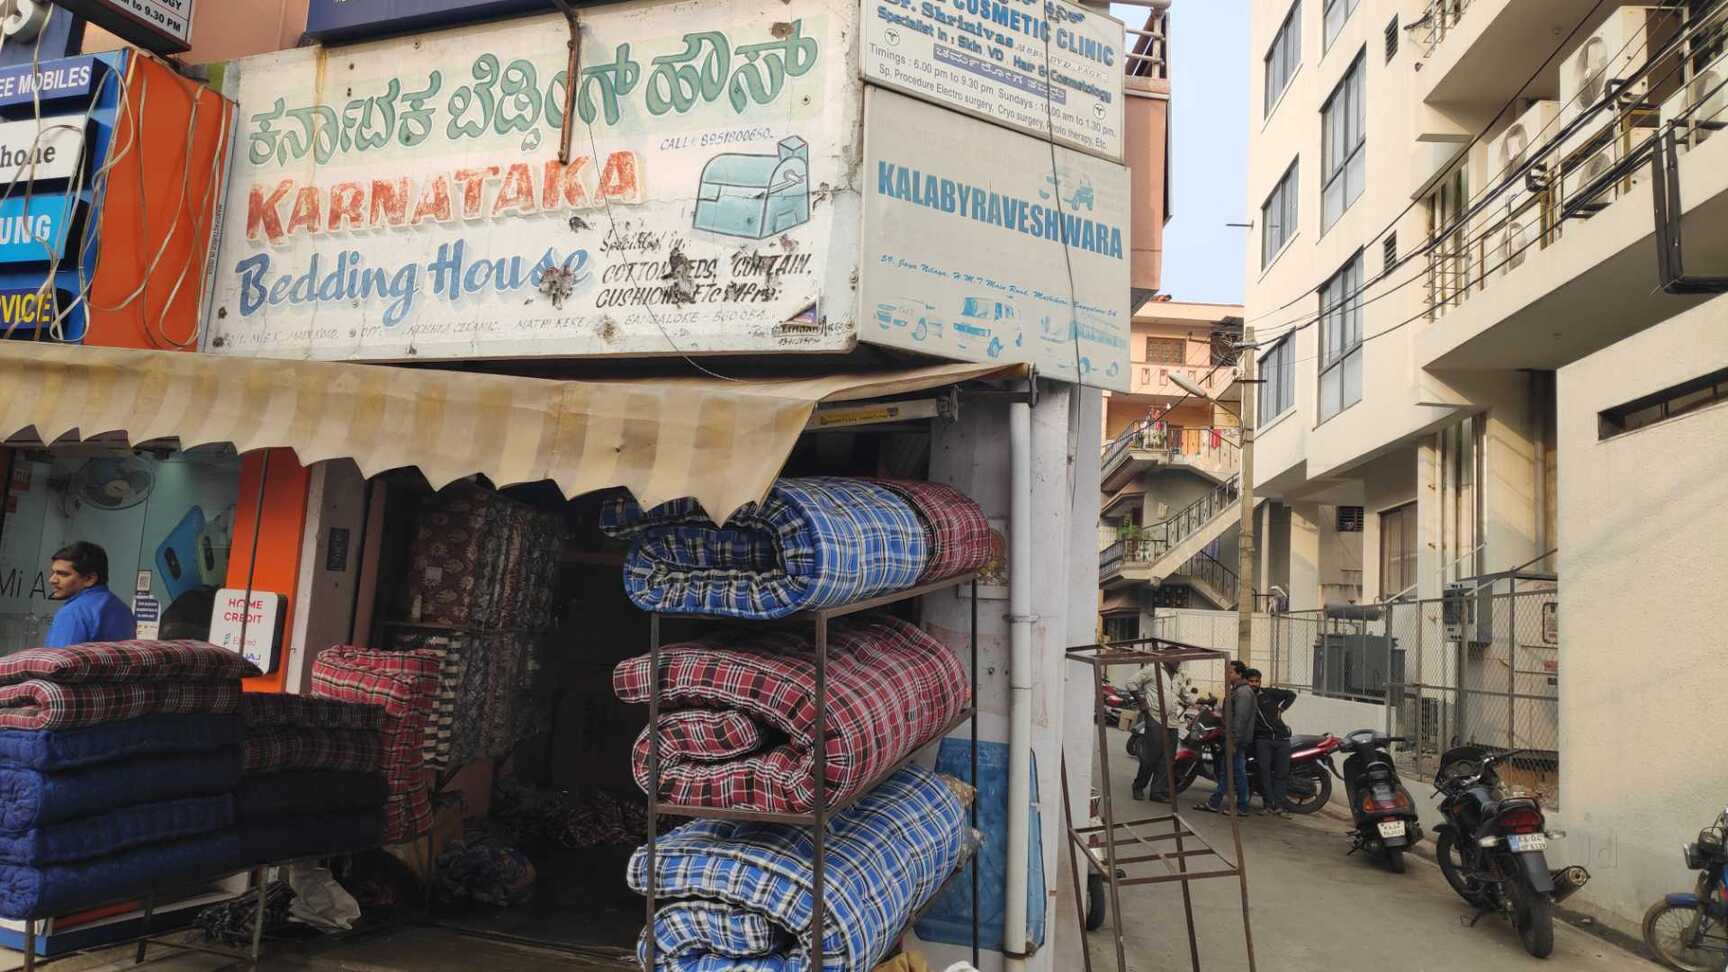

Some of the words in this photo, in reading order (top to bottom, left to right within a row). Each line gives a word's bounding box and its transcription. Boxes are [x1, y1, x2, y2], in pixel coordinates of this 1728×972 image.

[144, 6, 165, 24] 9.30
[167, 18, 181, 31] PM
[869, 43, 907, 65] Timings
[950, 73, 959, 84] to
[1056, 27, 1114, 67] CLINIC
[18, 65, 91, 94] MOBILES
[249, 70, 442, 167] ಕರ್ನಾಟಕ
[246, 150, 641, 241] KARNATAKA
[877, 160, 1124, 260] KALABYRAVESHWARA
[234, 249, 417, 328] Bedding
[228, 598, 264, 610] HOME
